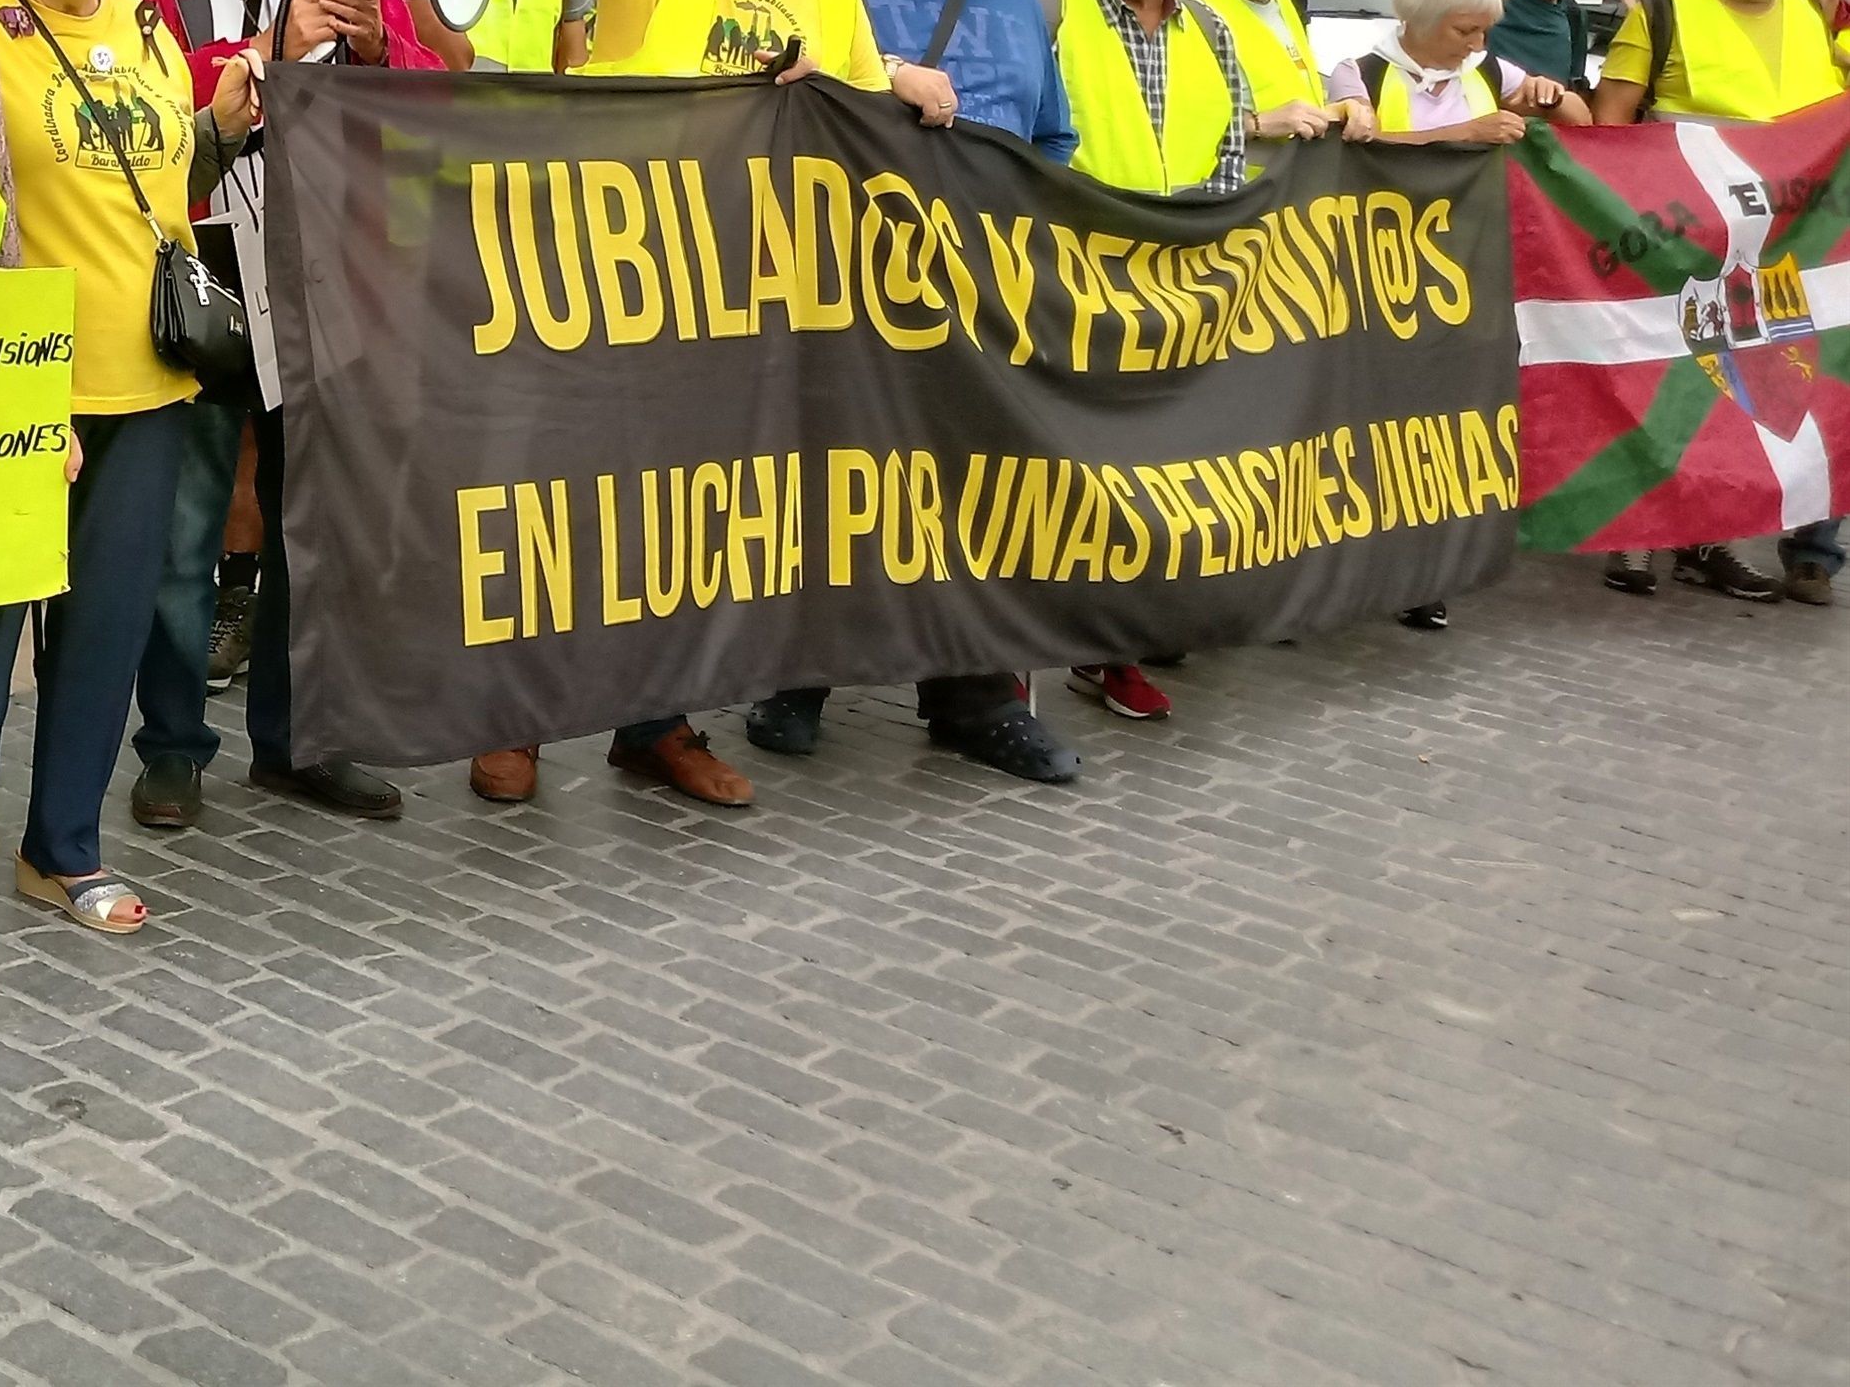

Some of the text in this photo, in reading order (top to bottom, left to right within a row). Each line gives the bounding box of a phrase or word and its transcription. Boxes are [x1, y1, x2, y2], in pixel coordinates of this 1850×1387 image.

[978, 212, 1035, 366] Y
[456, 478, 573, 647] EN
[596, 451, 804, 627] LUCHA
[827, 448, 952, 587] POR
[958, 453, 1150, 582] UNAS
[1133, 425, 1371, 582] PENSIONES
